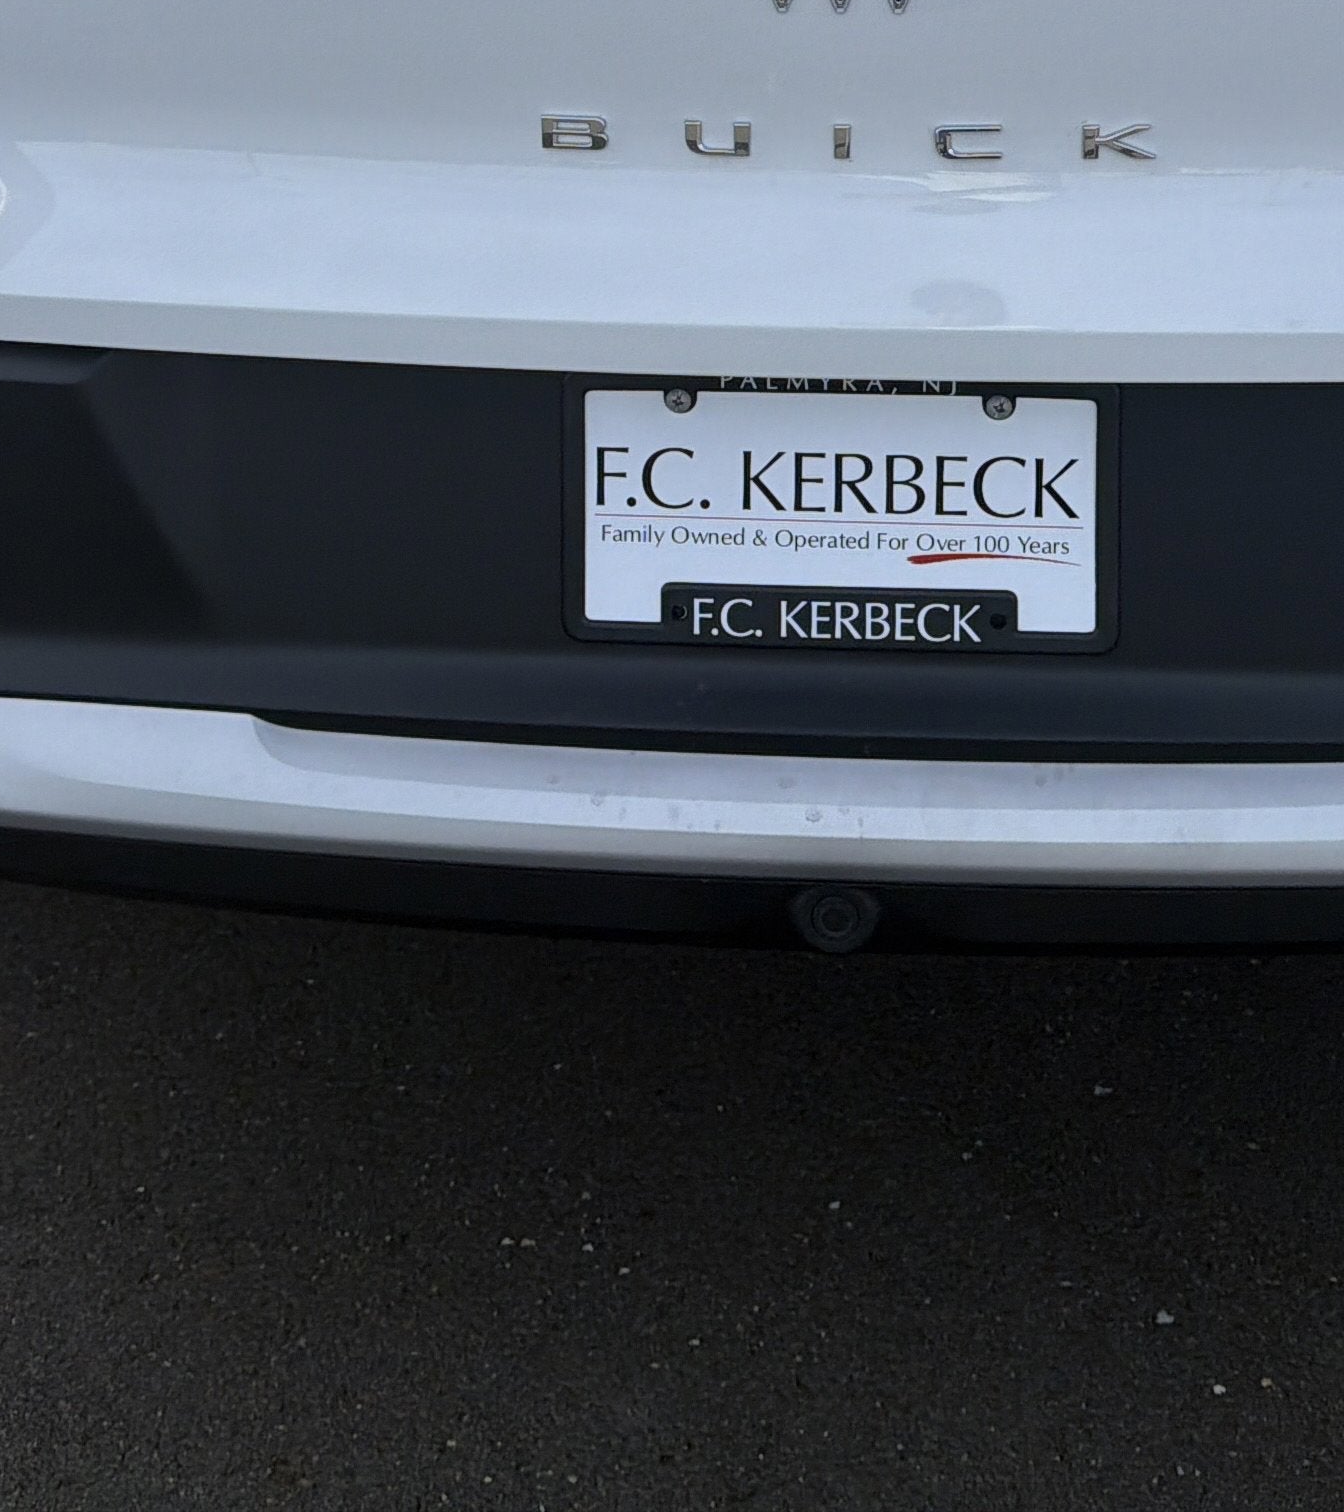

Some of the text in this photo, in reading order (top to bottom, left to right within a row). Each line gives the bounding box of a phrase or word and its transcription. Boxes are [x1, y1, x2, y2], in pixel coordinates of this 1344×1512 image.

[541, 114, 1157, 160] BUICK
[596, 447, 1080, 519] F.C. KERBECK
[602, 524, 1070, 555] Family Owned & Operated For Over 100 Years
[692, 598, 983, 644] F.C. KERBECK
